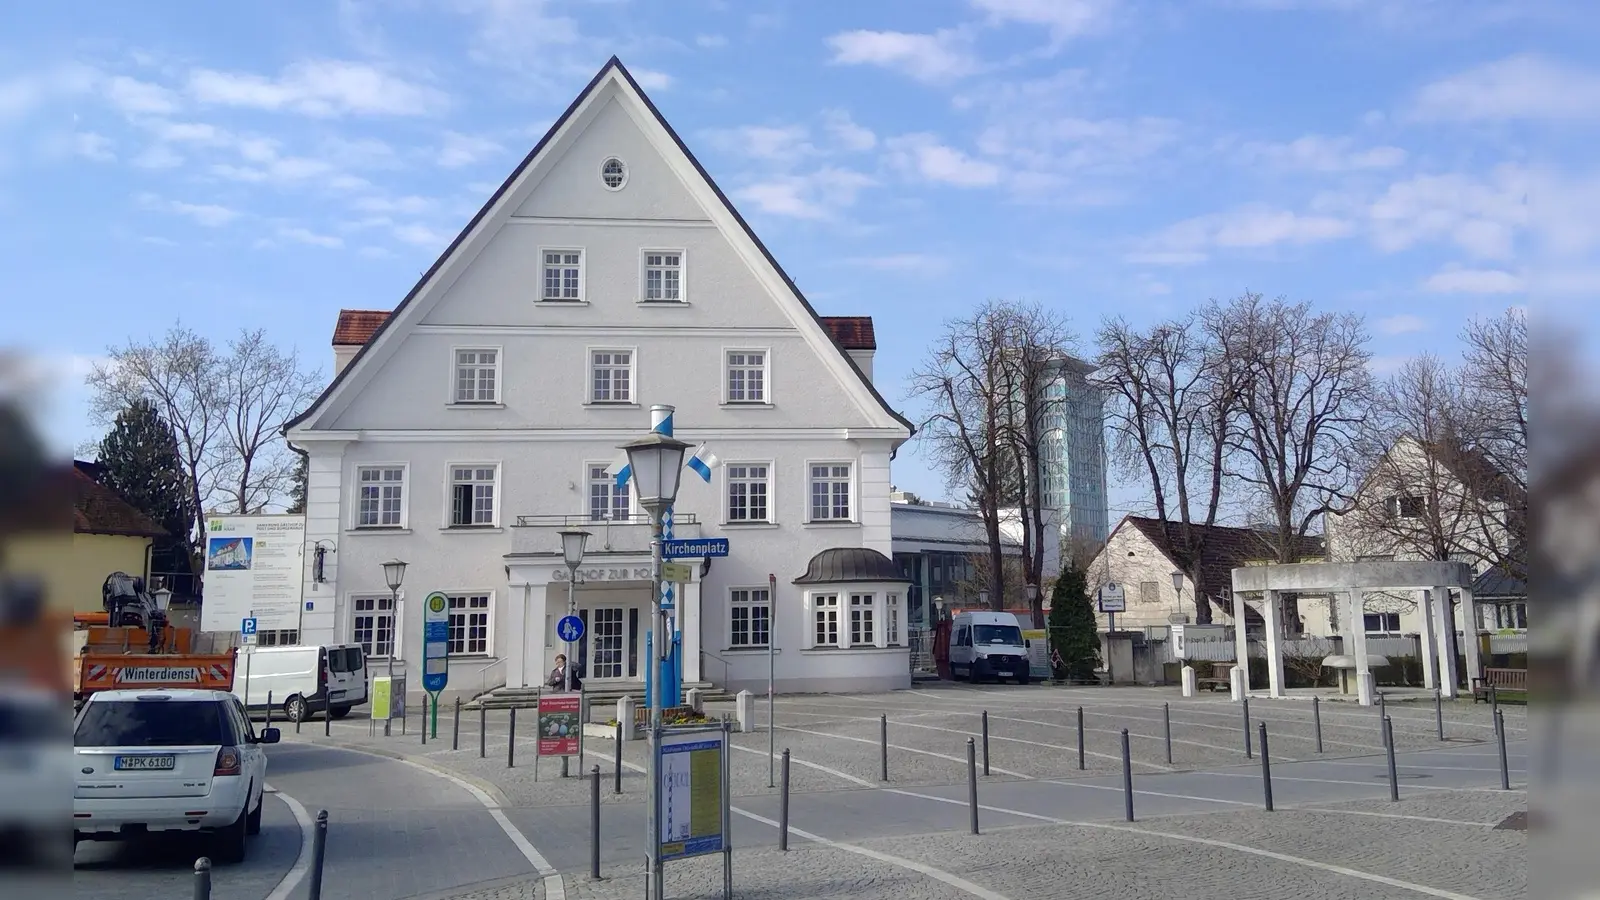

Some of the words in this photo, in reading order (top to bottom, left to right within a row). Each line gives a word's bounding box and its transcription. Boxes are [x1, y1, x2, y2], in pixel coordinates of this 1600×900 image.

[665, 542, 726, 557] Kirchenplatz
[552, 569, 604, 581] GATHOF
[608, 568, 629, 580] ZUR
[633, 568, 652, 580] PO
[244, 620, 254, 633] P
[124, 667, 194, 680] Winterdienst
[148, 757, 173, 767] 6180
